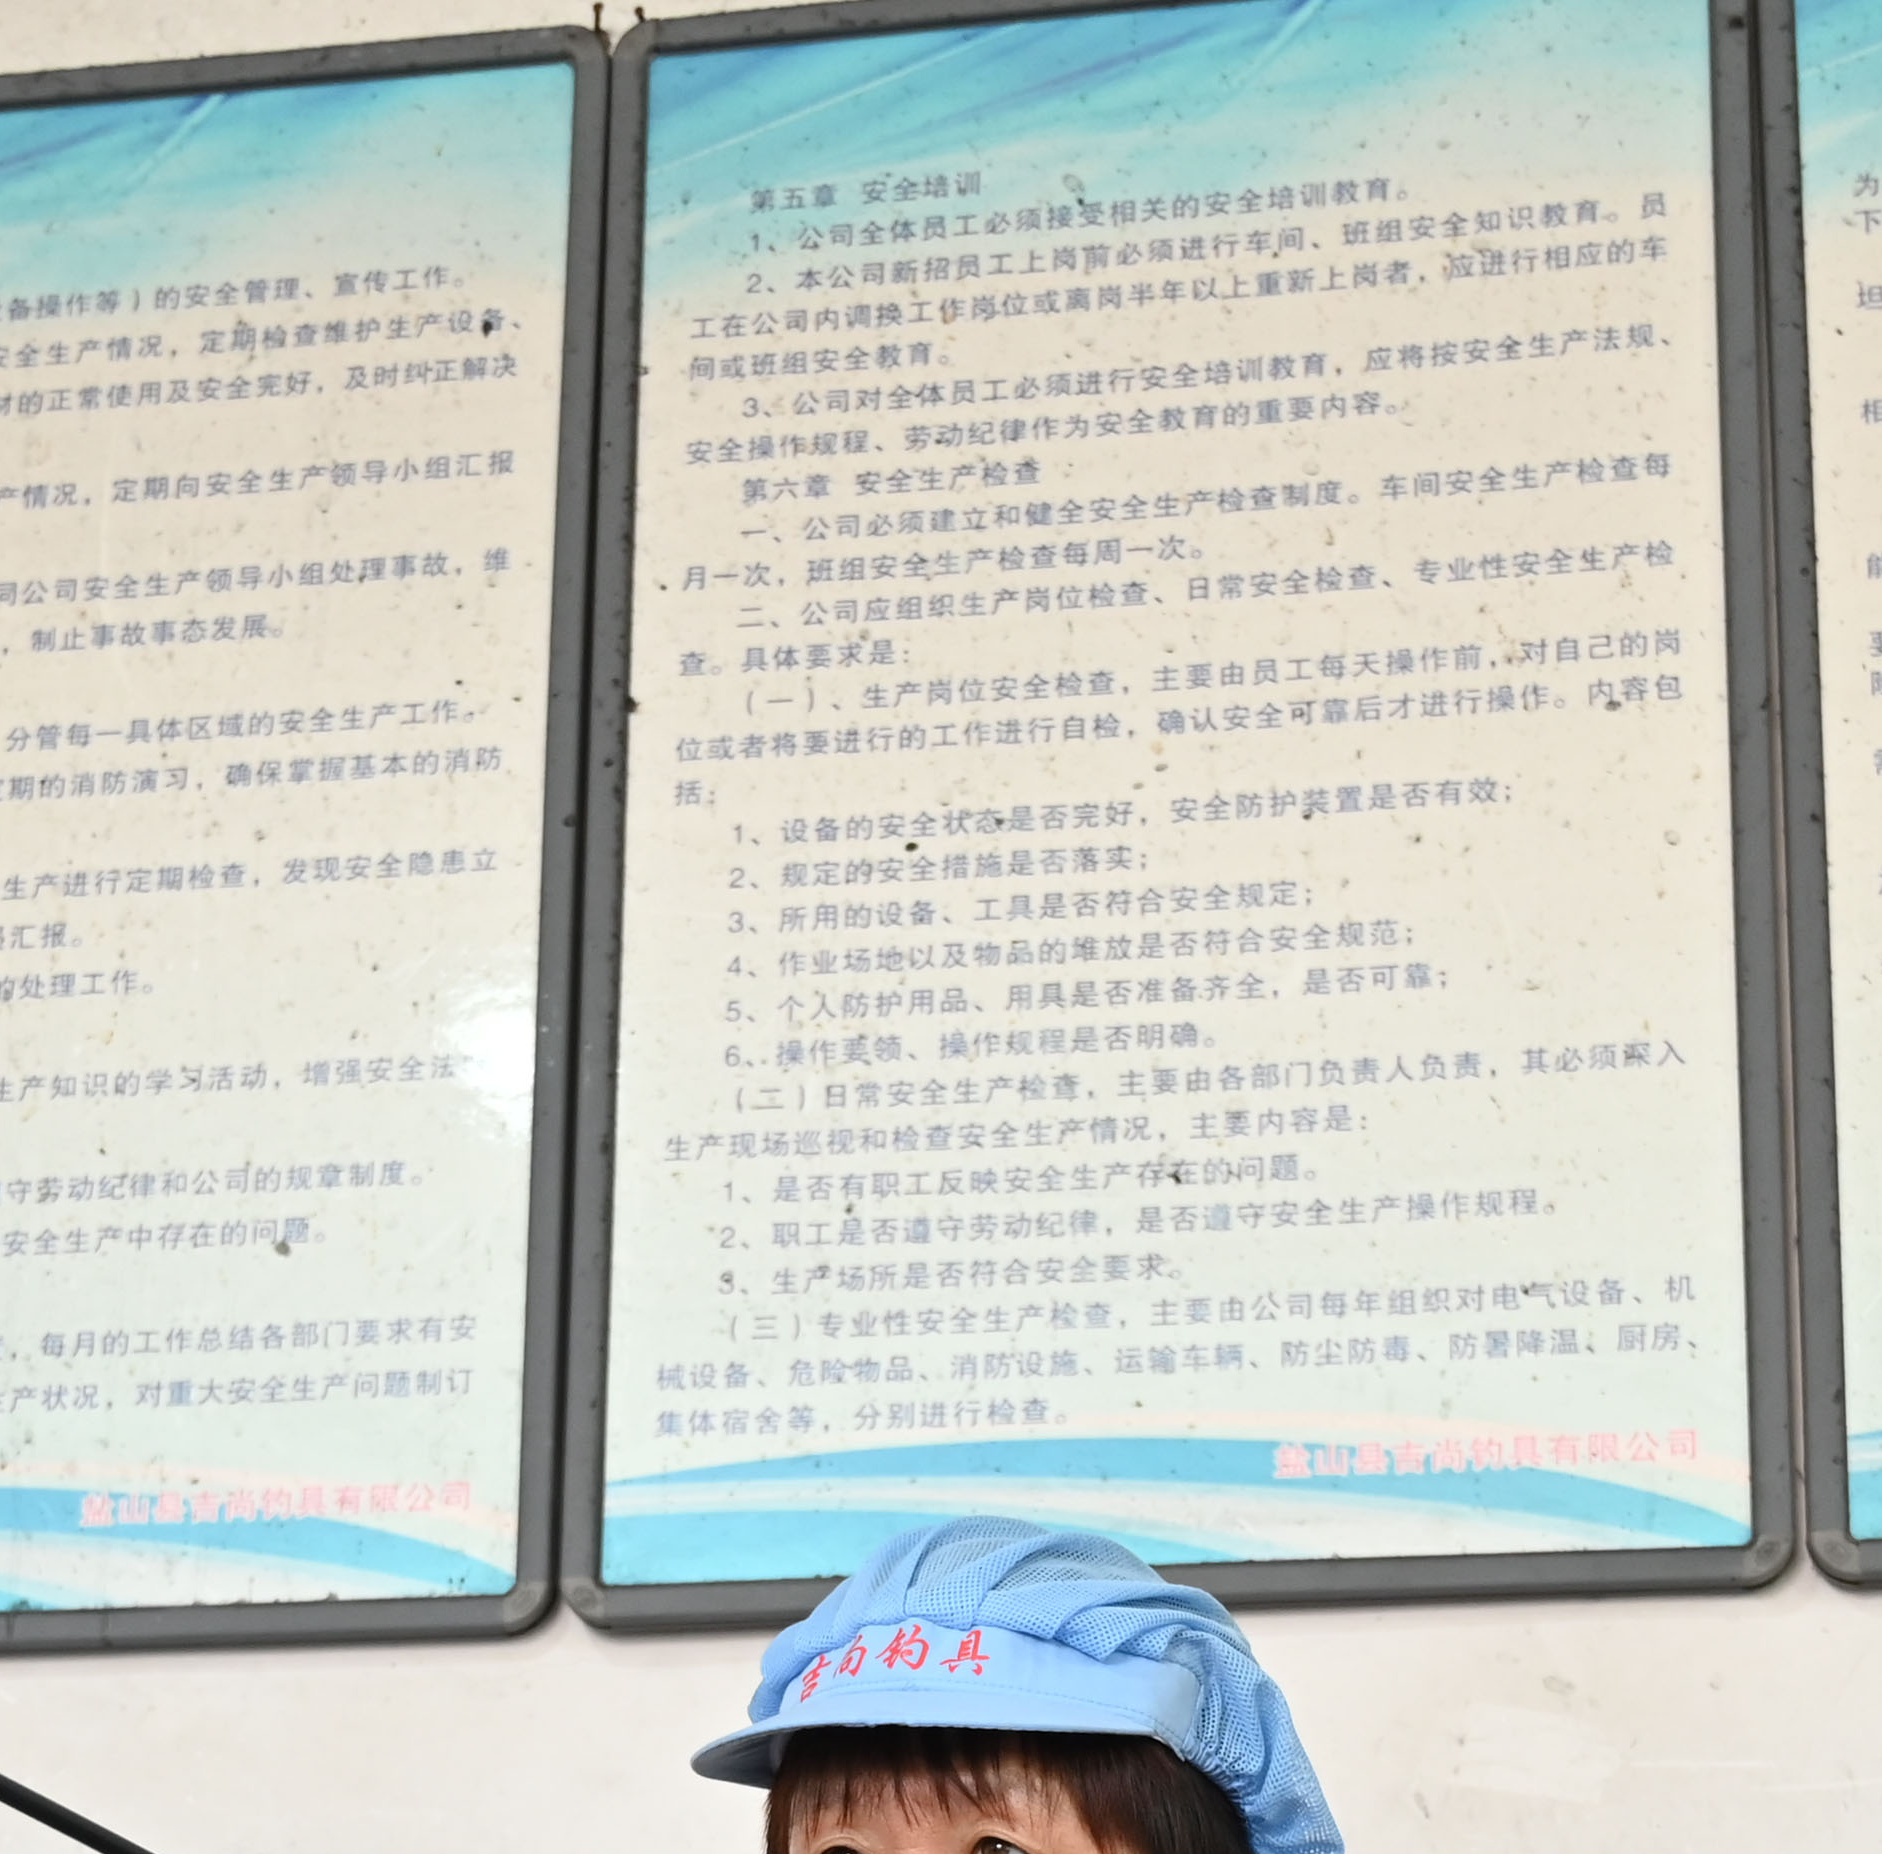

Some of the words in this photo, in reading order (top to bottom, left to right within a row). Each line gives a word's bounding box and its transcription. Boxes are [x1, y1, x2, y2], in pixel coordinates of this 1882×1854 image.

[743, 171, 1411, 258] 1、公司全体员工必须接受相关的安全培训教育。
[750, 180, 836, 215] 第五章
[862, 169, 980, 208] 安全培训
[683, 336, 952, 384] 间或班组安全教育。
[685, 387, 1408, 468] 安全操作规程、劳动纪律作为安全教育的重要内容。
[741, 471, 830, 506] 第六章
[855, 455, 1040, 497] 安全生产检查
[682, 532, 1204, 593] 月一次，班组安全生产检查每周一次。
[736, 538, 1673, 635] 二、公司应组织生产岗位检查、日常安全检查、专业性安全生产检
[679, 634, 912, 679] 查。具体要求是：
[673, 777, 716, 808] 括：
[733, 774, 1519, 850] 1、设备的安全状态是否完好，安全防护装置是否有效；
[728, 842, 1146, 893] 2、规定的安全措施是否落实；
[727, 877, 1314, 938] 3、所用的设备、工具是否符合安全规定；
[726, 916, 1413, 982] 4、作业场地以及物品的堆放是否符合安全规范；
[725, 960, 1448, 1026] 5、个人防护用品、用具是否准备齐全，是否可靠；
[724, 1018, 1216, 1071] 6、操作要领、操作规程是否明确。
[664, 1102, 1368, 1165] 生产现场巡视和检查安全生产情况，主要内容是：
[723, 1150, 1319, 1208] 1、是否有职工反映安全生产存在的问题。
[719, 1185, 1558, 1254] 2、职工是否遵守劳动纪律，是否遵守安全生产操作规程。
[718, 1250, 1186, 1297] 3、生产场所是否符合安全要求。
[656, 1394, 1066, 1441] 集体宿舍等，分别进行检查。
[798, 1622, 992, 1703] 吉尚钓具
